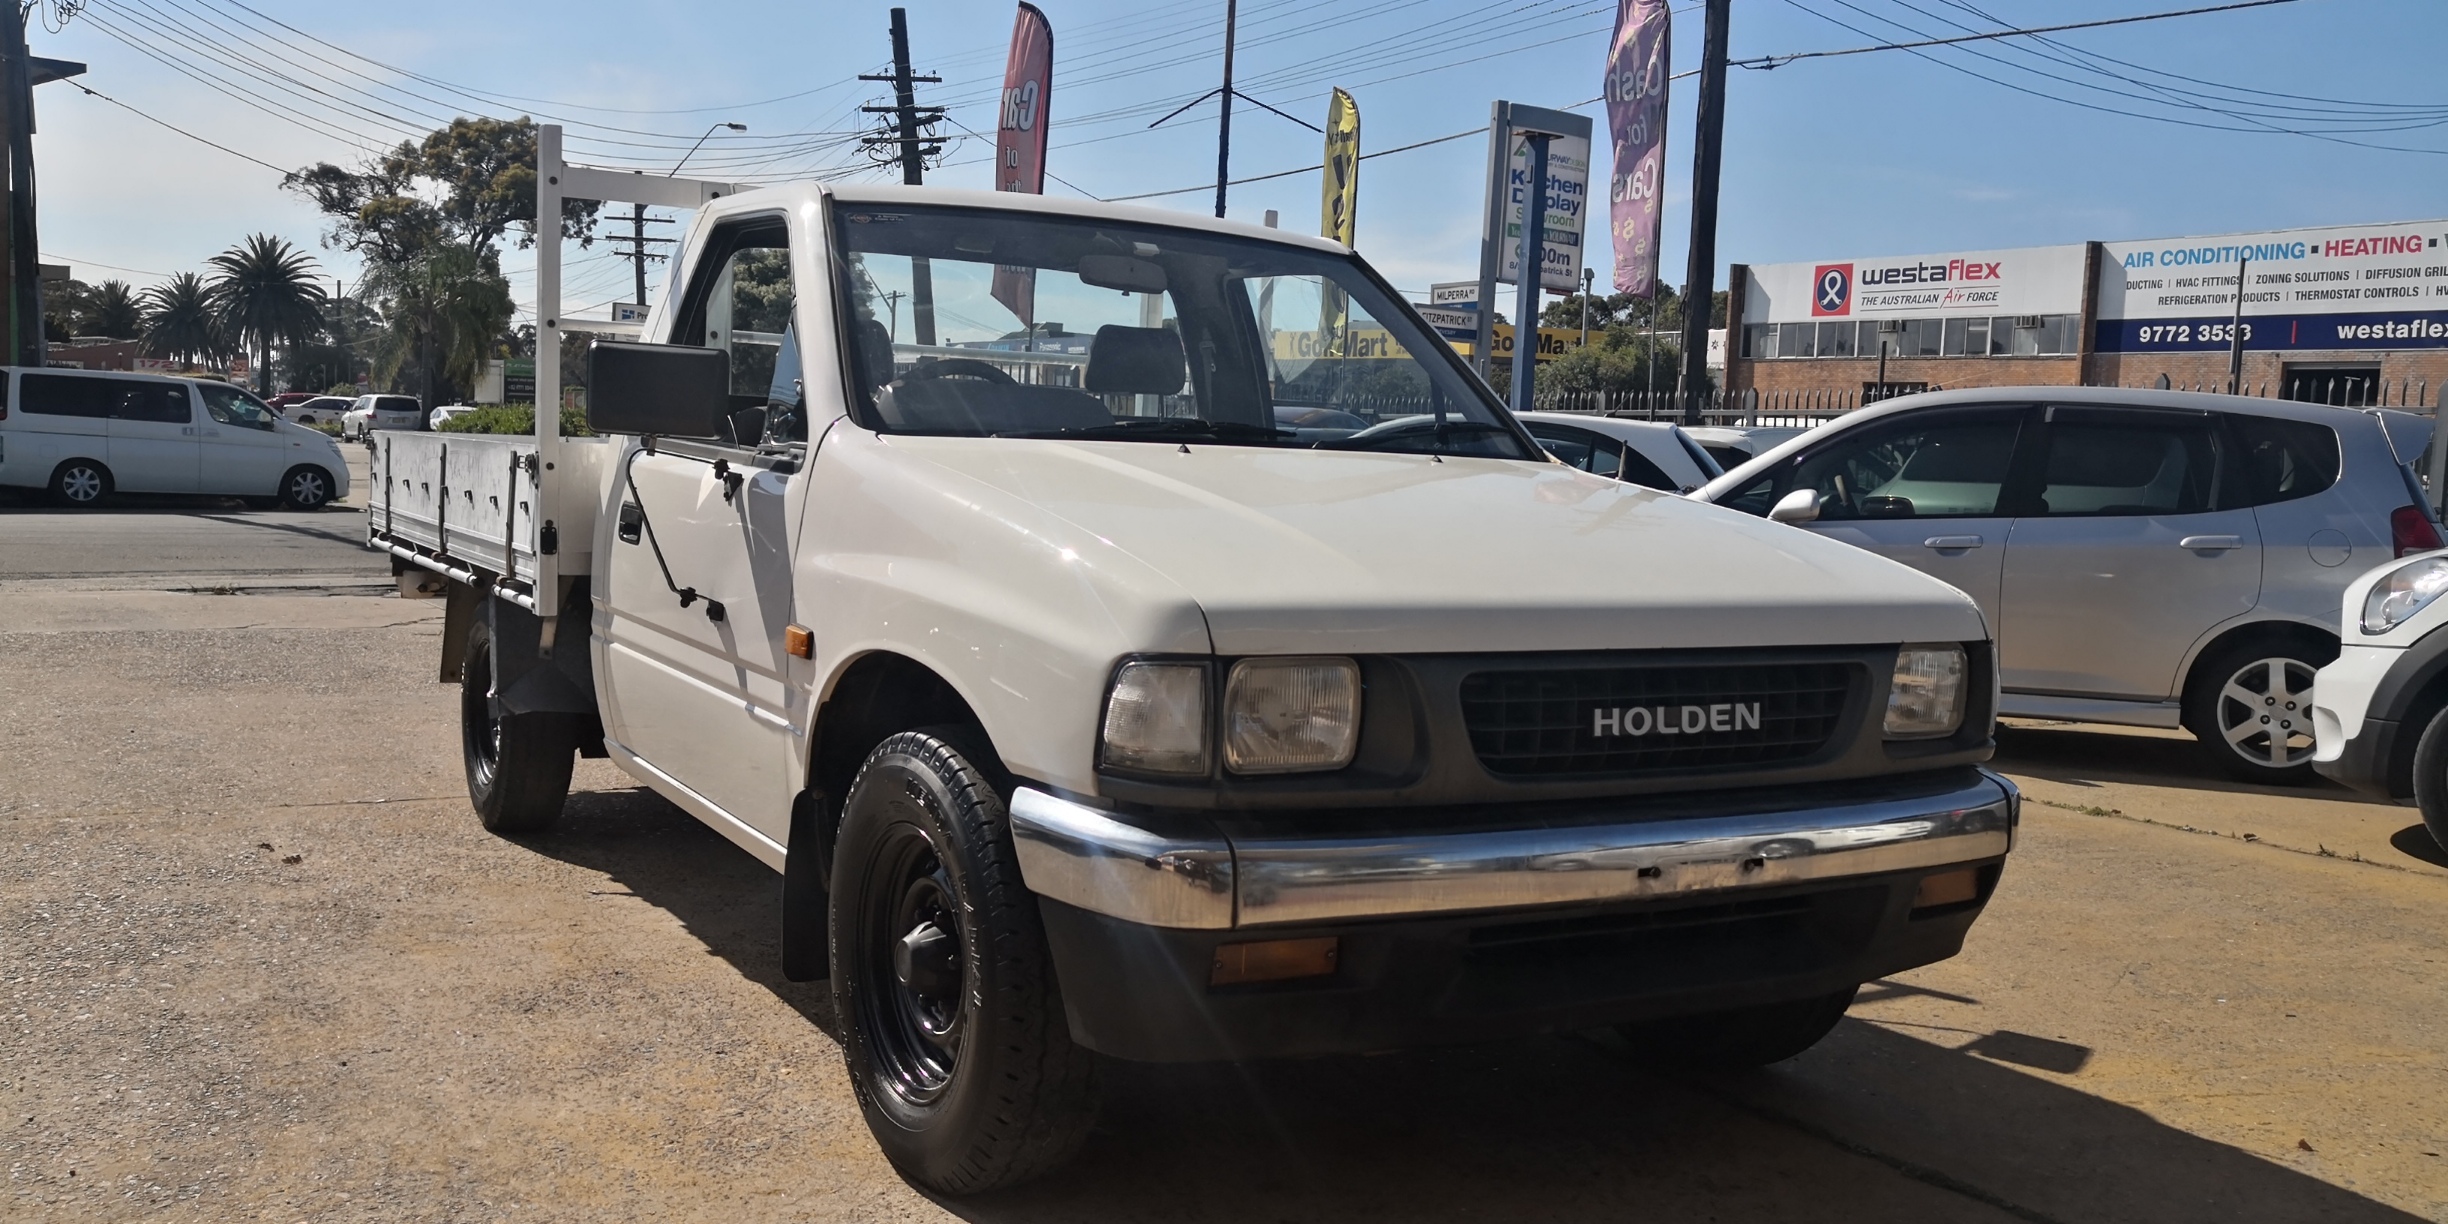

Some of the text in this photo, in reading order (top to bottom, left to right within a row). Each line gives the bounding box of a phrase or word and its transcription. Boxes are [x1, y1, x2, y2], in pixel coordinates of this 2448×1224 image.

[1511, 168, 1583, 195] Kchen
[1511, 187, 1581, 216] Dplay
[1515, 206, 1575, 228] Sroom
[2124, 252, 2154, 268] AIR
[2160, 242, 2306, 267] CONDITIONING
[2324, 235, 2423, 257] HEATING
[1862, 259, 2002, 286] westaflex
[2126, 279, 2163, 290] DUCTING
[2176, 278, 2200, 288] HVAC
[2201, 275, 2241, 287] FITTINGS
[2256, 273, 2292, 284] ZONING
[2294, 270, 2350, 283] SOLUTIONS
[2365, 267, 2421, 280] DIFFUSION
[1437, 290, 1469, 301] MILPERRA
[1861, 296, 1878, 306] THE
[1880, 294, 1940, 306] AUSTRALIAN
[1966, 291, 2000, 302] FORCE
[2158, 294, 2228, 306] REFRIGERATION
[2231, 291, 2281, 303] PODUCTS
[2295, 288, 2361, 301] THERMOSTAT
[2364, 286, 2420, 299] CONTROLS
[1490, 329, 1515, 352] Go
[2139, 319, 2448, 343] 9772 3533 westafle
[1297, 331, 1334, 357] Go
[1344, 331, 1388, 357] Mart
[139, 359, 175, 369] 172
[1594, 702, 1760, 737] HOLDEN
